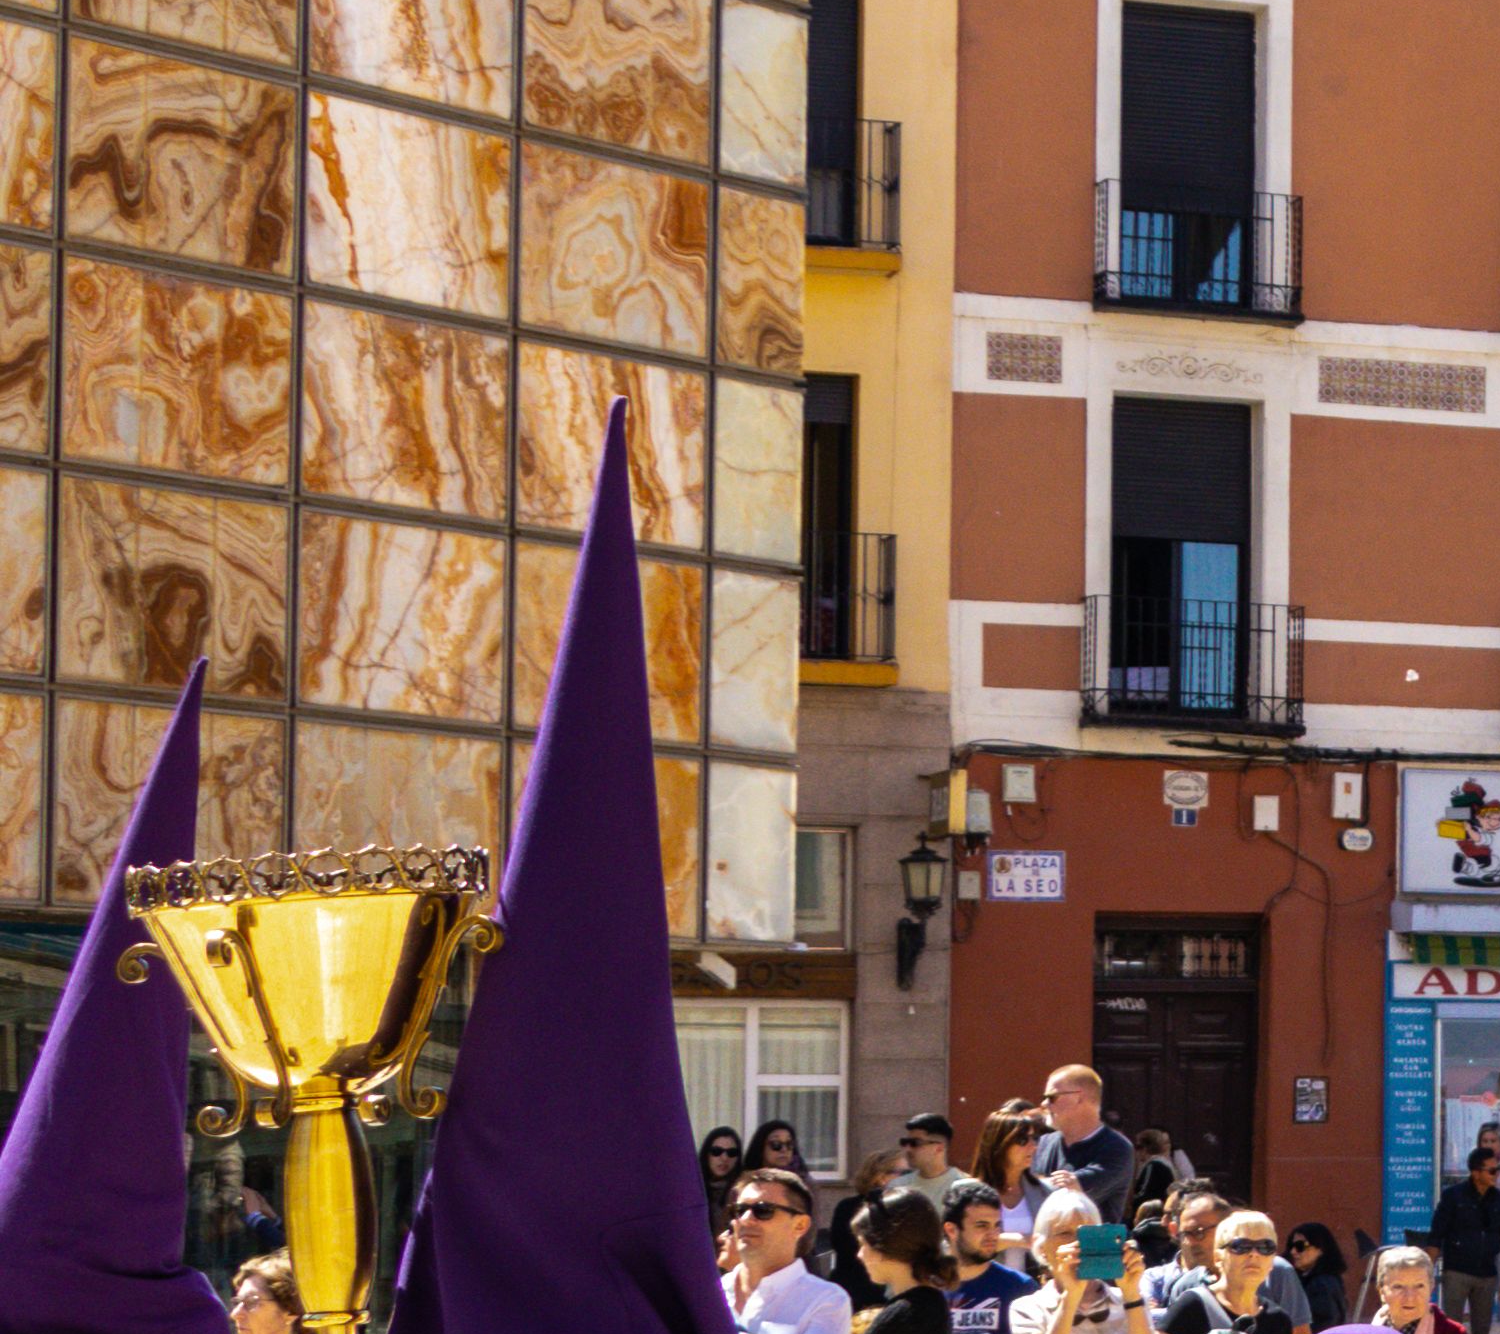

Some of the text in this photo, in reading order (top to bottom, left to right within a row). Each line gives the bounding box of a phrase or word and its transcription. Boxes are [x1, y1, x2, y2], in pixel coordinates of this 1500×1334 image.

[1014, 857, 1058, 868] PLAZA
[995, 879, 1058, 893] LA SEO
[957, 1311, 995, 1327] JEANS
